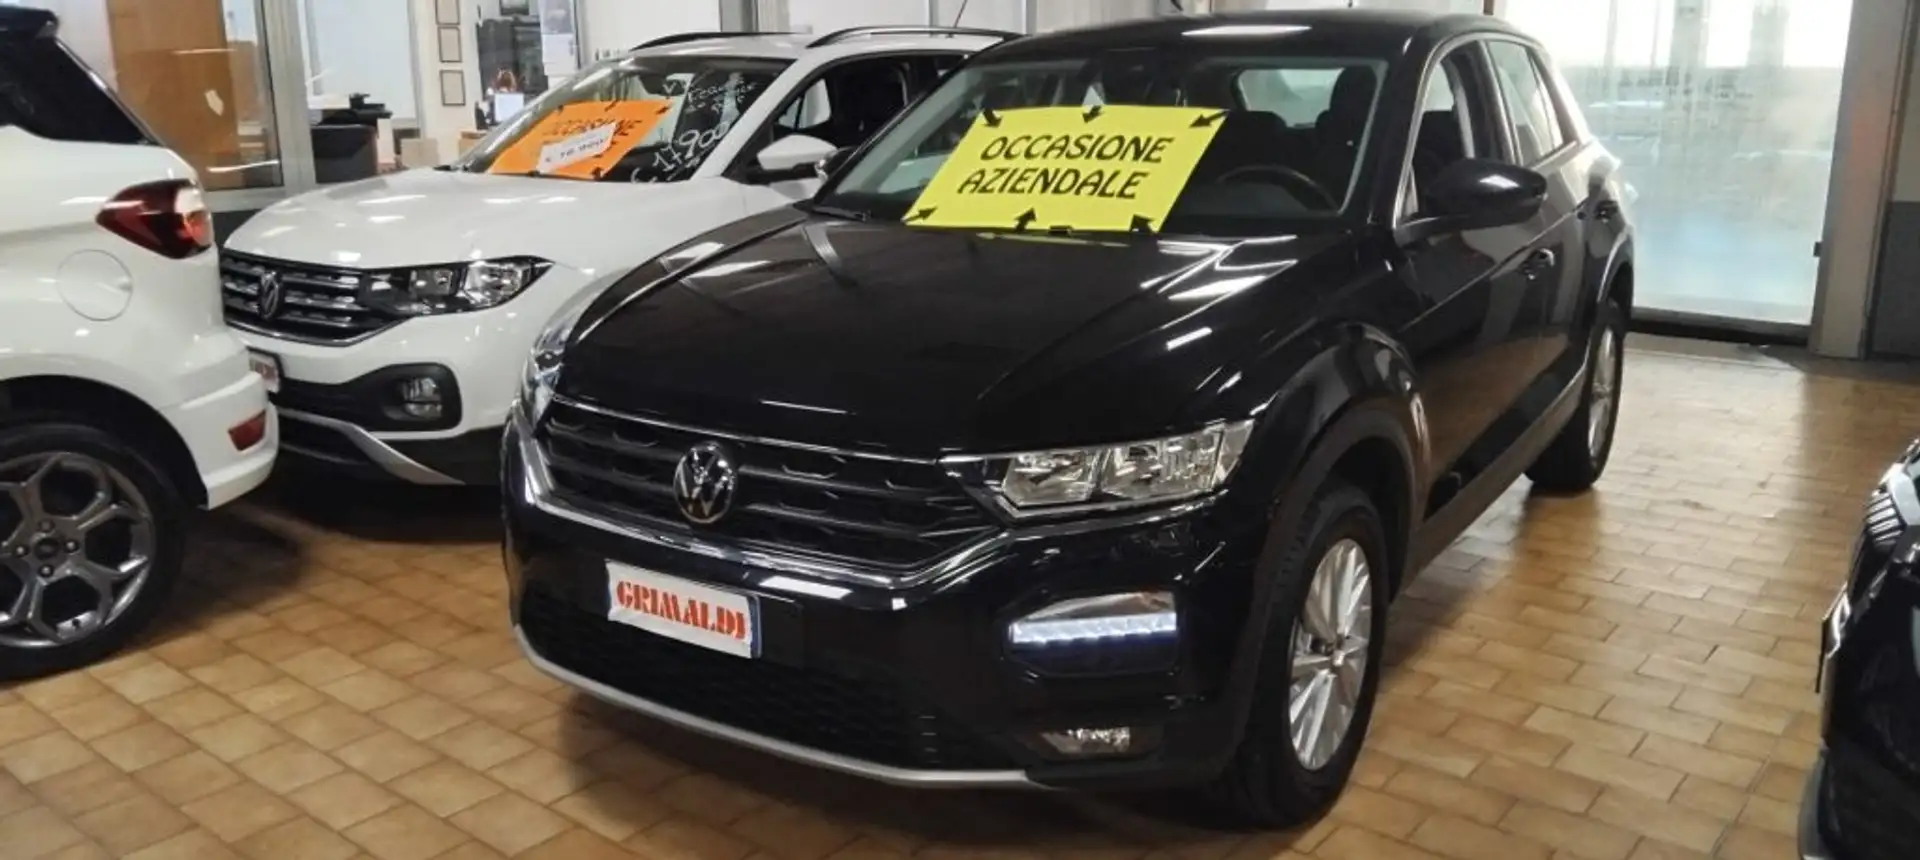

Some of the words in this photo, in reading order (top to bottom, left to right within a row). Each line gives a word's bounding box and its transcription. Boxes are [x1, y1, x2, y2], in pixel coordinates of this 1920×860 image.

[980, 134, 1175, 163] OCCASIONE
[957, 167, 1149, 199] AZIENDALE
[616, 580, 746, 641] GRIMALDI
